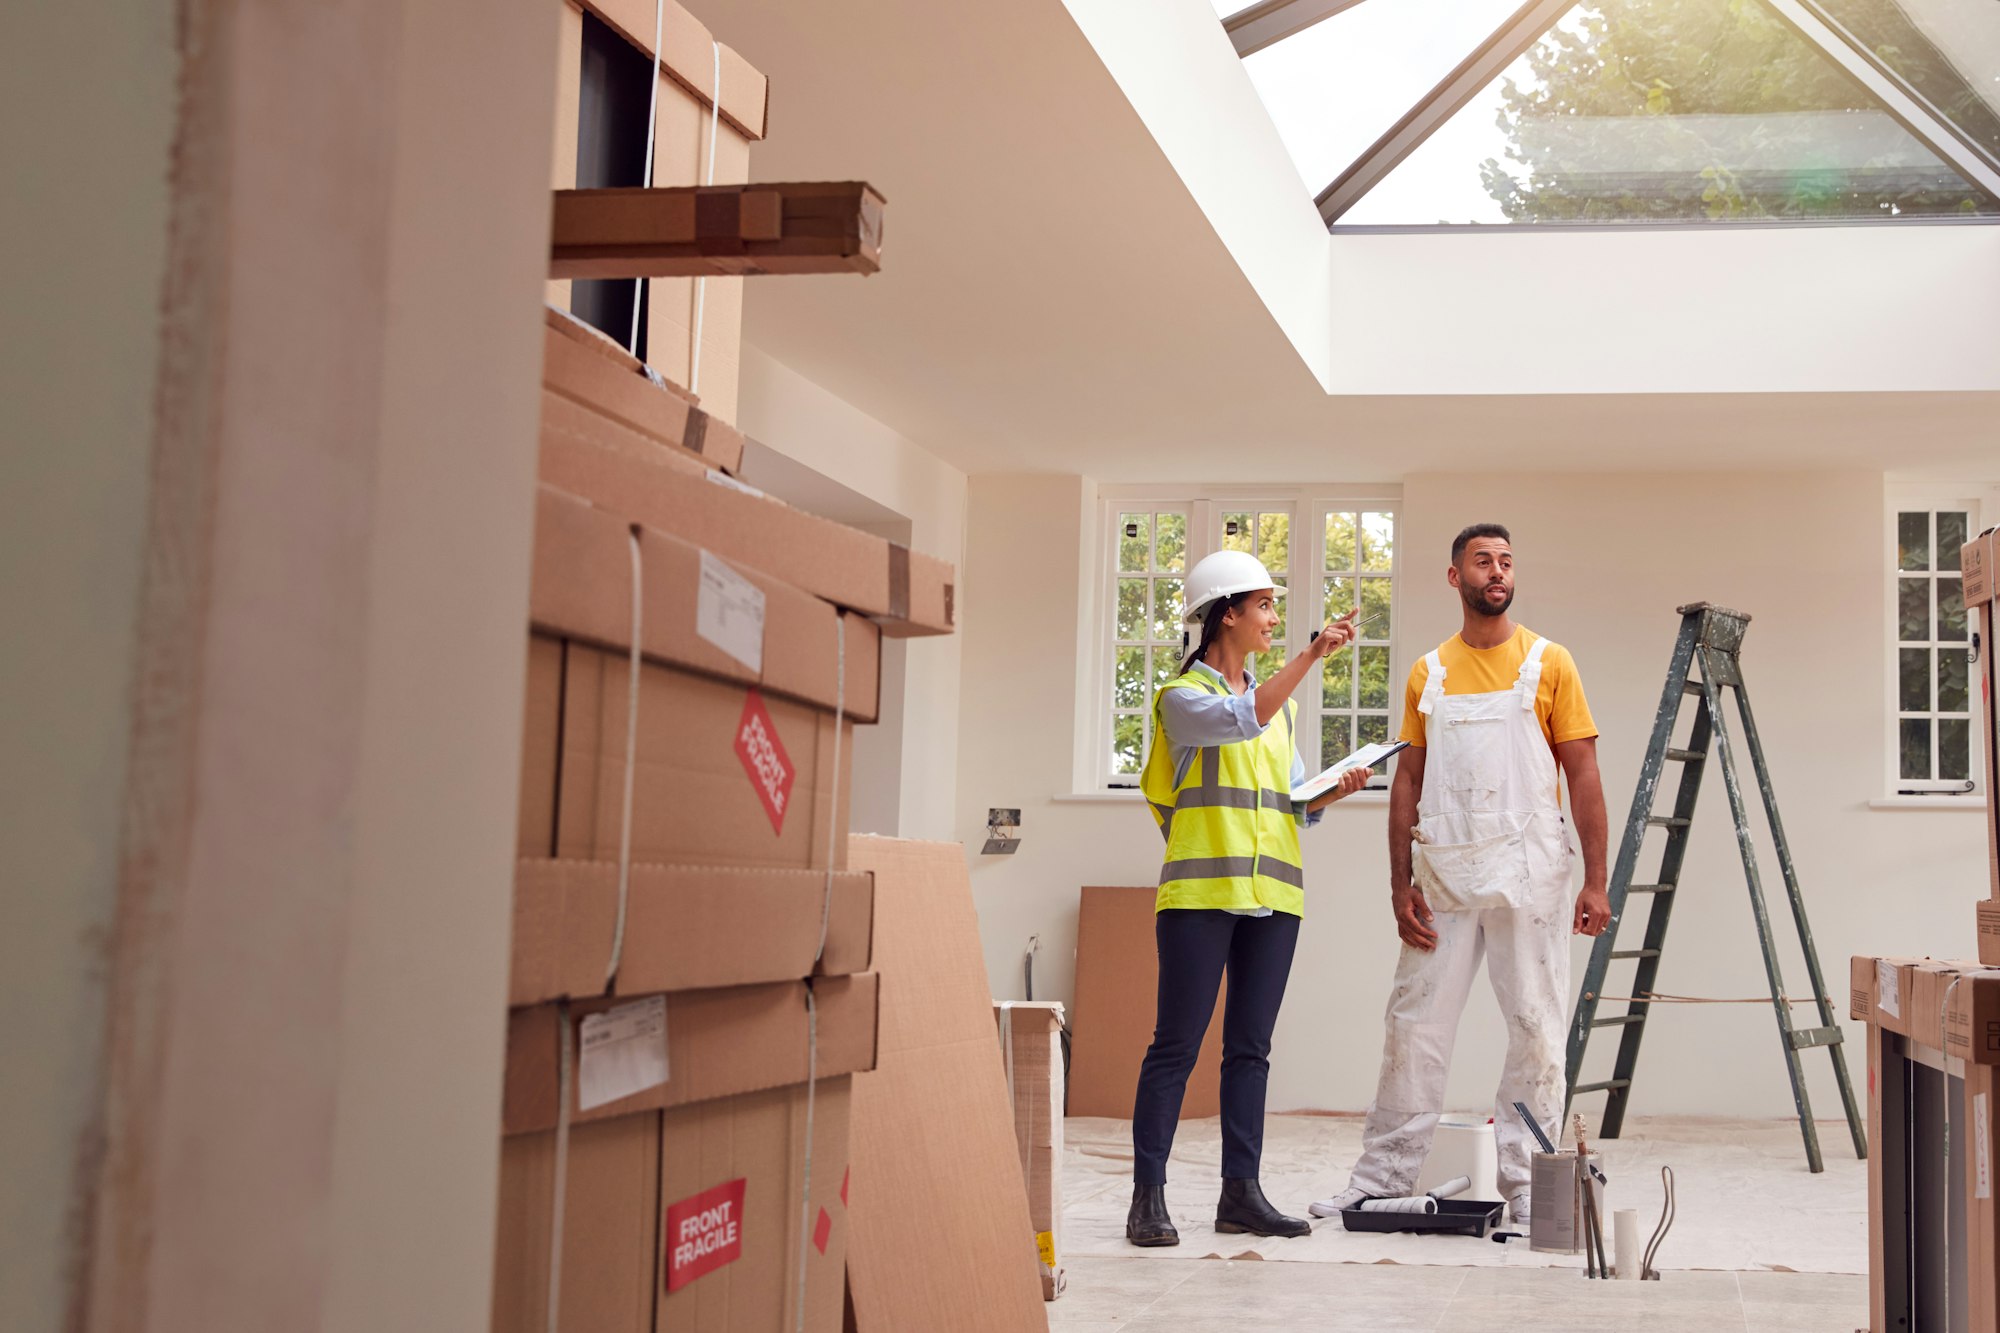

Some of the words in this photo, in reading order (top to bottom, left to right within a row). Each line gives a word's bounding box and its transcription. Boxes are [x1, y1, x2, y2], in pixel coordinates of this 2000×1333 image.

[741, 723, 785, 815] FRAGILE
[751, 713, 786, 784] FRONT
[674, 1221, 737, 1270] FRAGILE
[681, 1200, 732, 1242] FRONT
